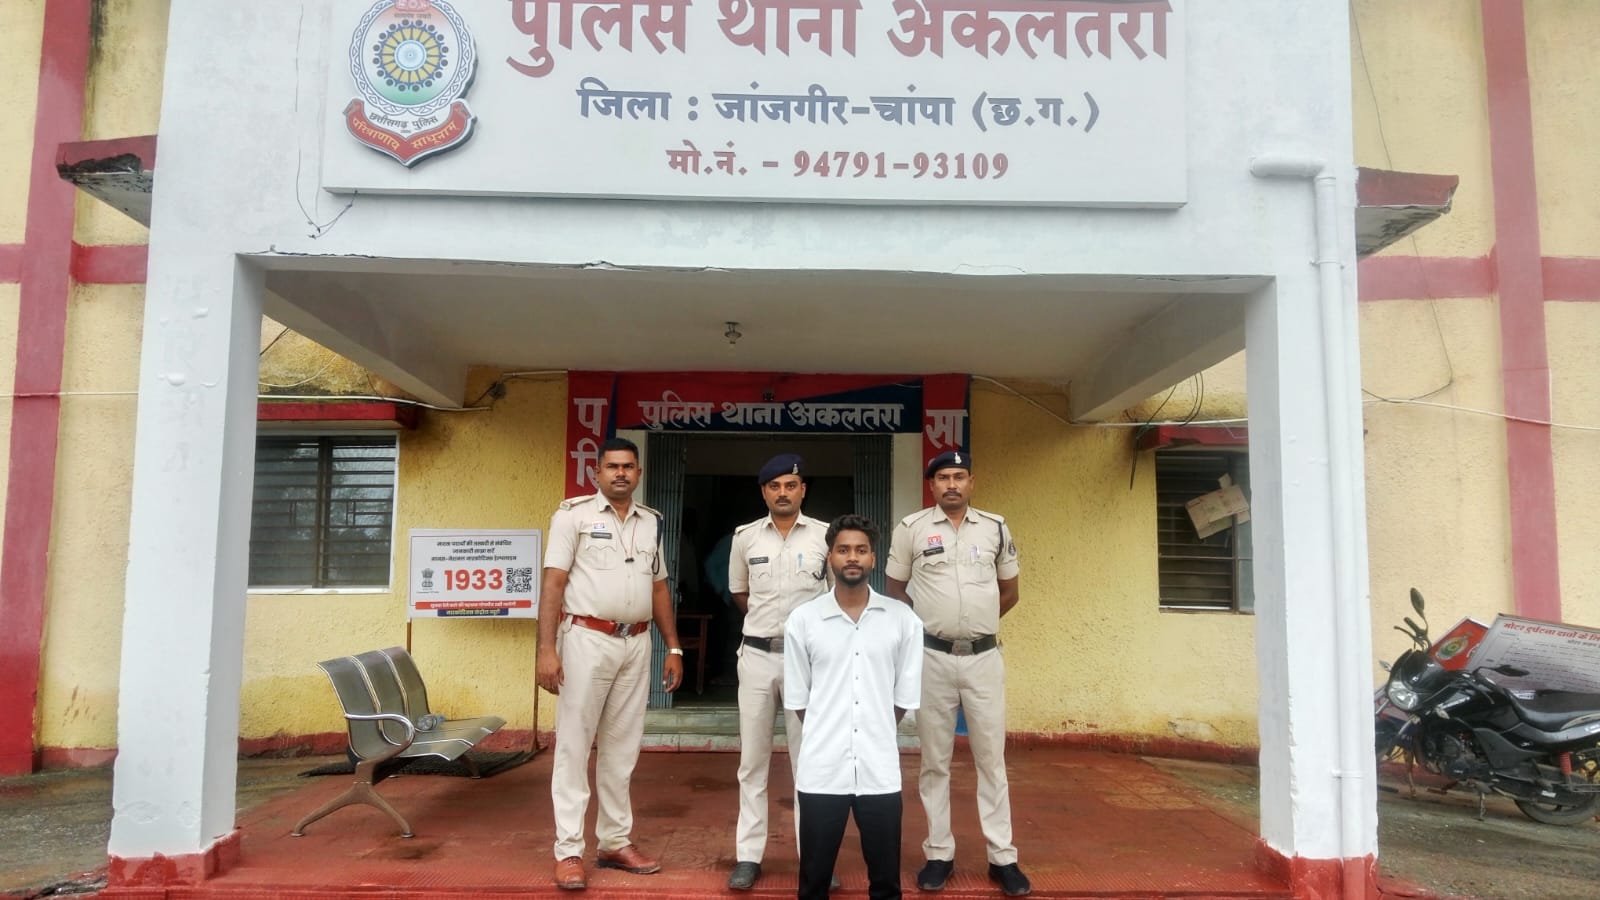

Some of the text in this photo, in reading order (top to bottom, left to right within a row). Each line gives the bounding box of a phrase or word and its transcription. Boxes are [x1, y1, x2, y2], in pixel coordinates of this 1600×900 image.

[716, 0, 863, 57] थाना
[887, 0, 1173, 60] अकलतरा
[412, 116, 439, 131] पुलिस
[576, 77, 672, 120] जिला
[712, 81, 956, 126] जांजगीर-चांपा
[972, 91, 1100, 133] (छ.ग.)
[665, 139, 748, 176] मो.नं.
[793, 150, 1009, 180] 94791-93109
[638, 390, 904, 431] पुलिस थाना अकलतरा
[444, 568, 503, 591] 1933
